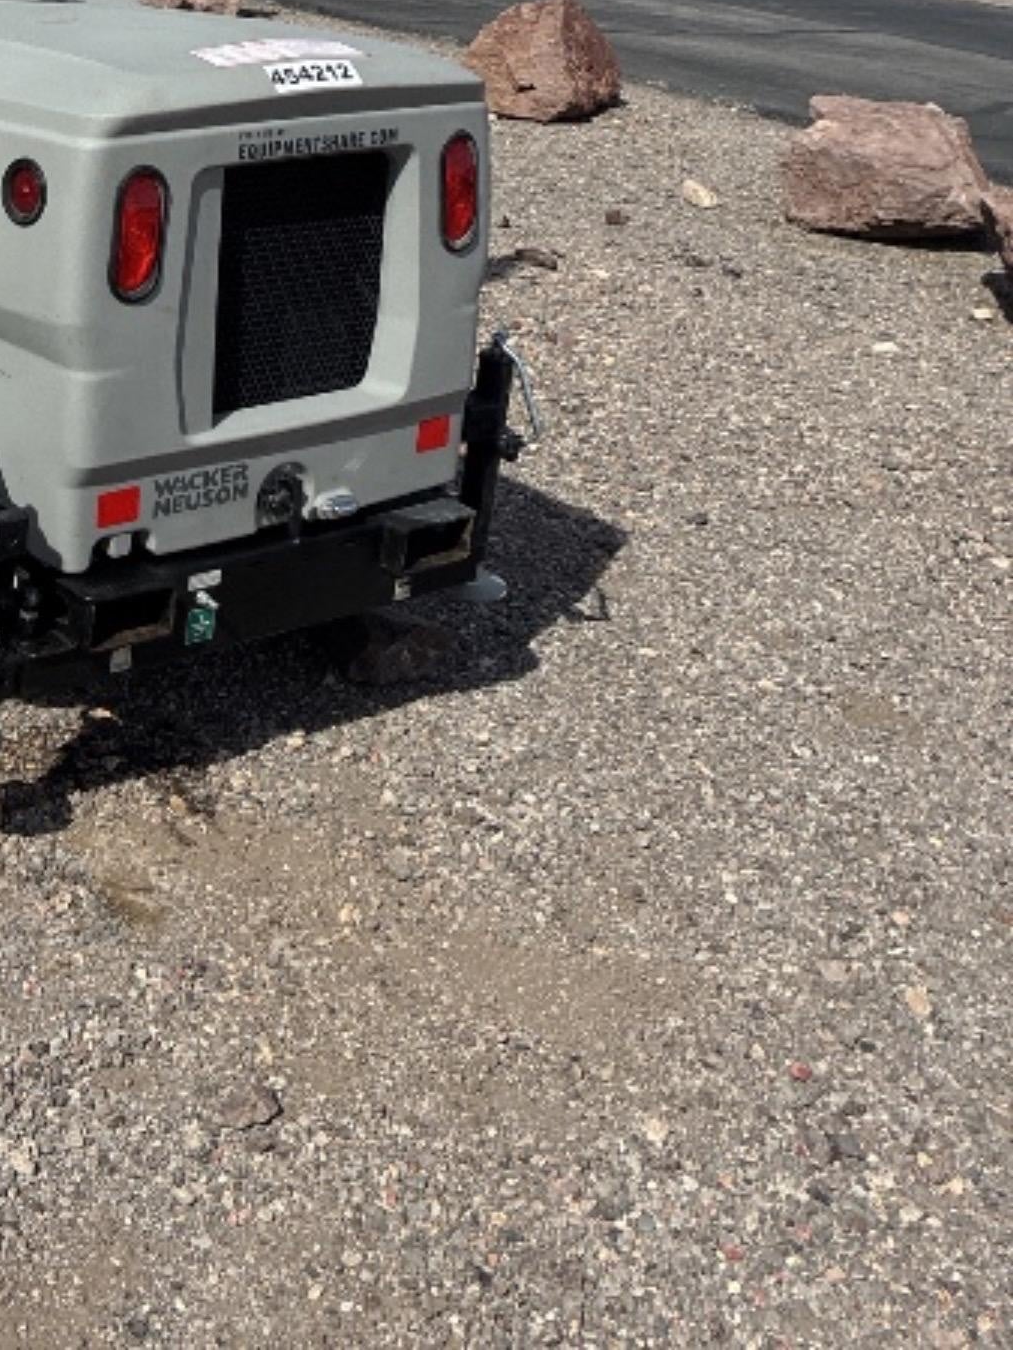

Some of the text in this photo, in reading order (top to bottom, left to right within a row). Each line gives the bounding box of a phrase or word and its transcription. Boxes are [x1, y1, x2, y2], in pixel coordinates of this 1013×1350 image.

[270, 62, 354, 86] 454212
[153, 463, 250, 498] WACKER
[151, 483, 249, 521] NEUSON
